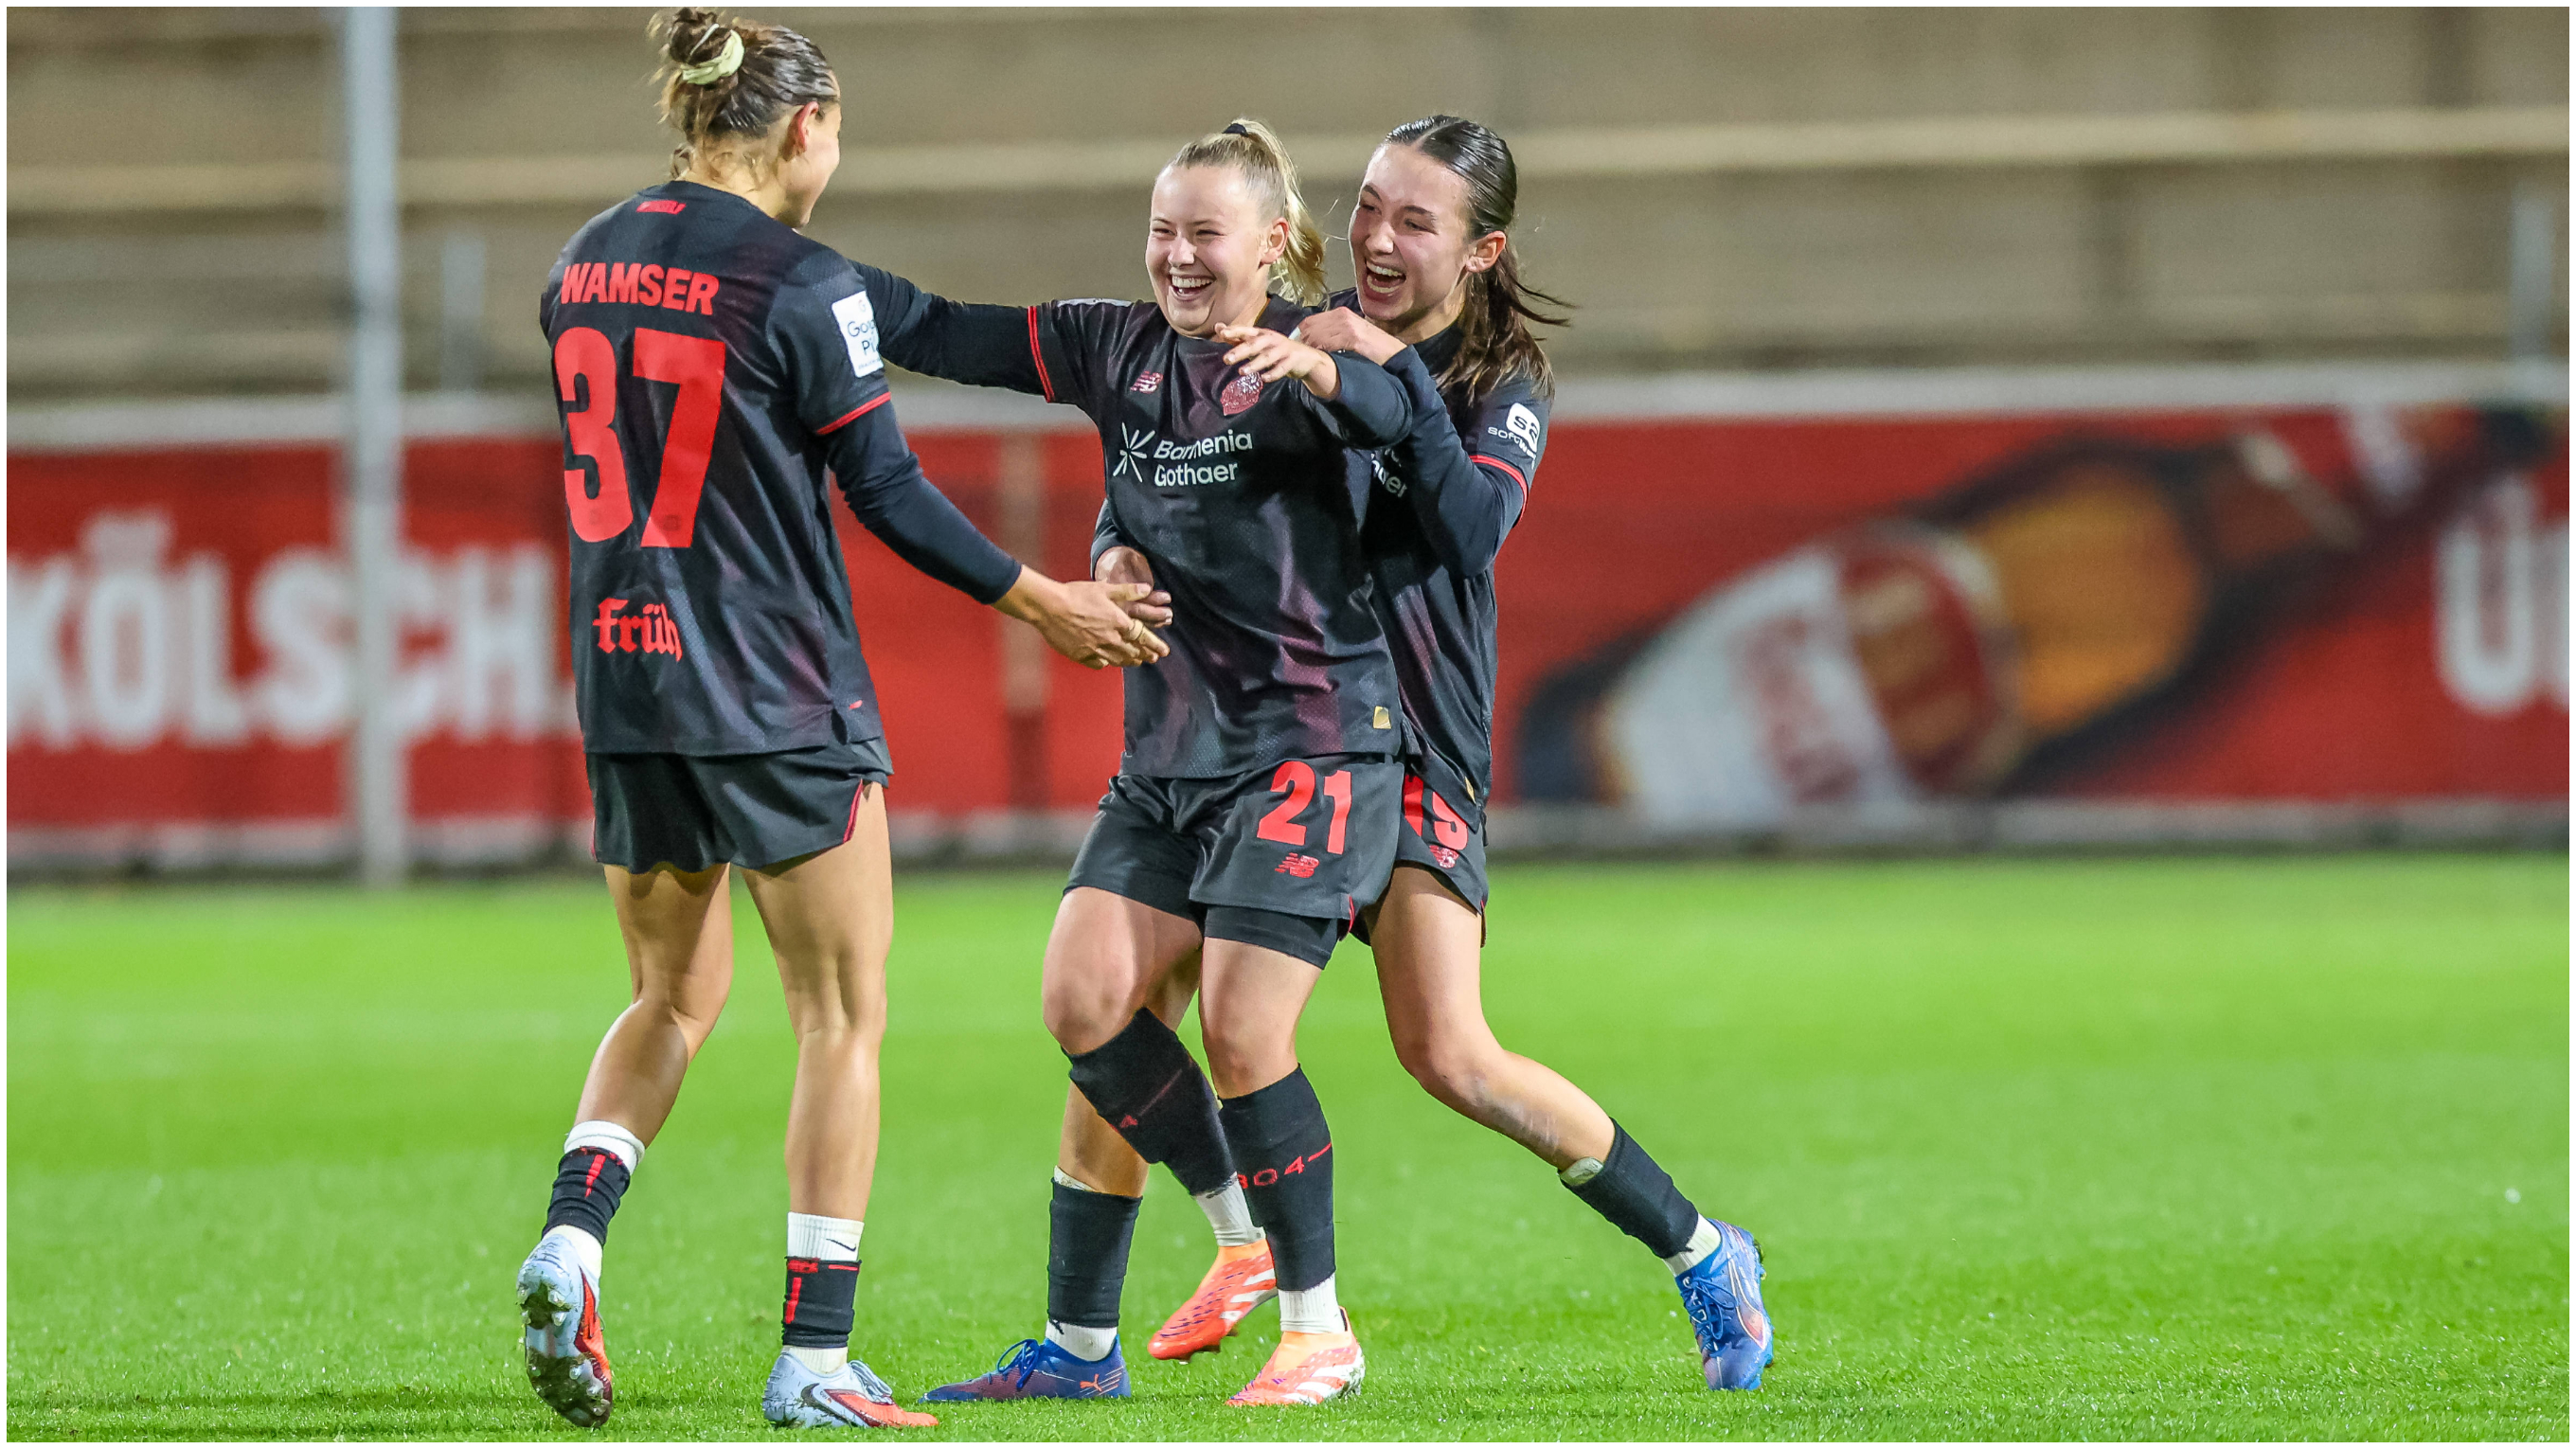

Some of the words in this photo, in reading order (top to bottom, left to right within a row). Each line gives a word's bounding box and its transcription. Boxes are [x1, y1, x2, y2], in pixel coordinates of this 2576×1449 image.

[561, 261, 720, 316] WAMSER
[554, 326, 726, 548] 37
[1154, 429, 1253, 460] Barmenia
[1154, 462, 1239, 487] Gothaer
[1257, 760, 1352, 855] 21
